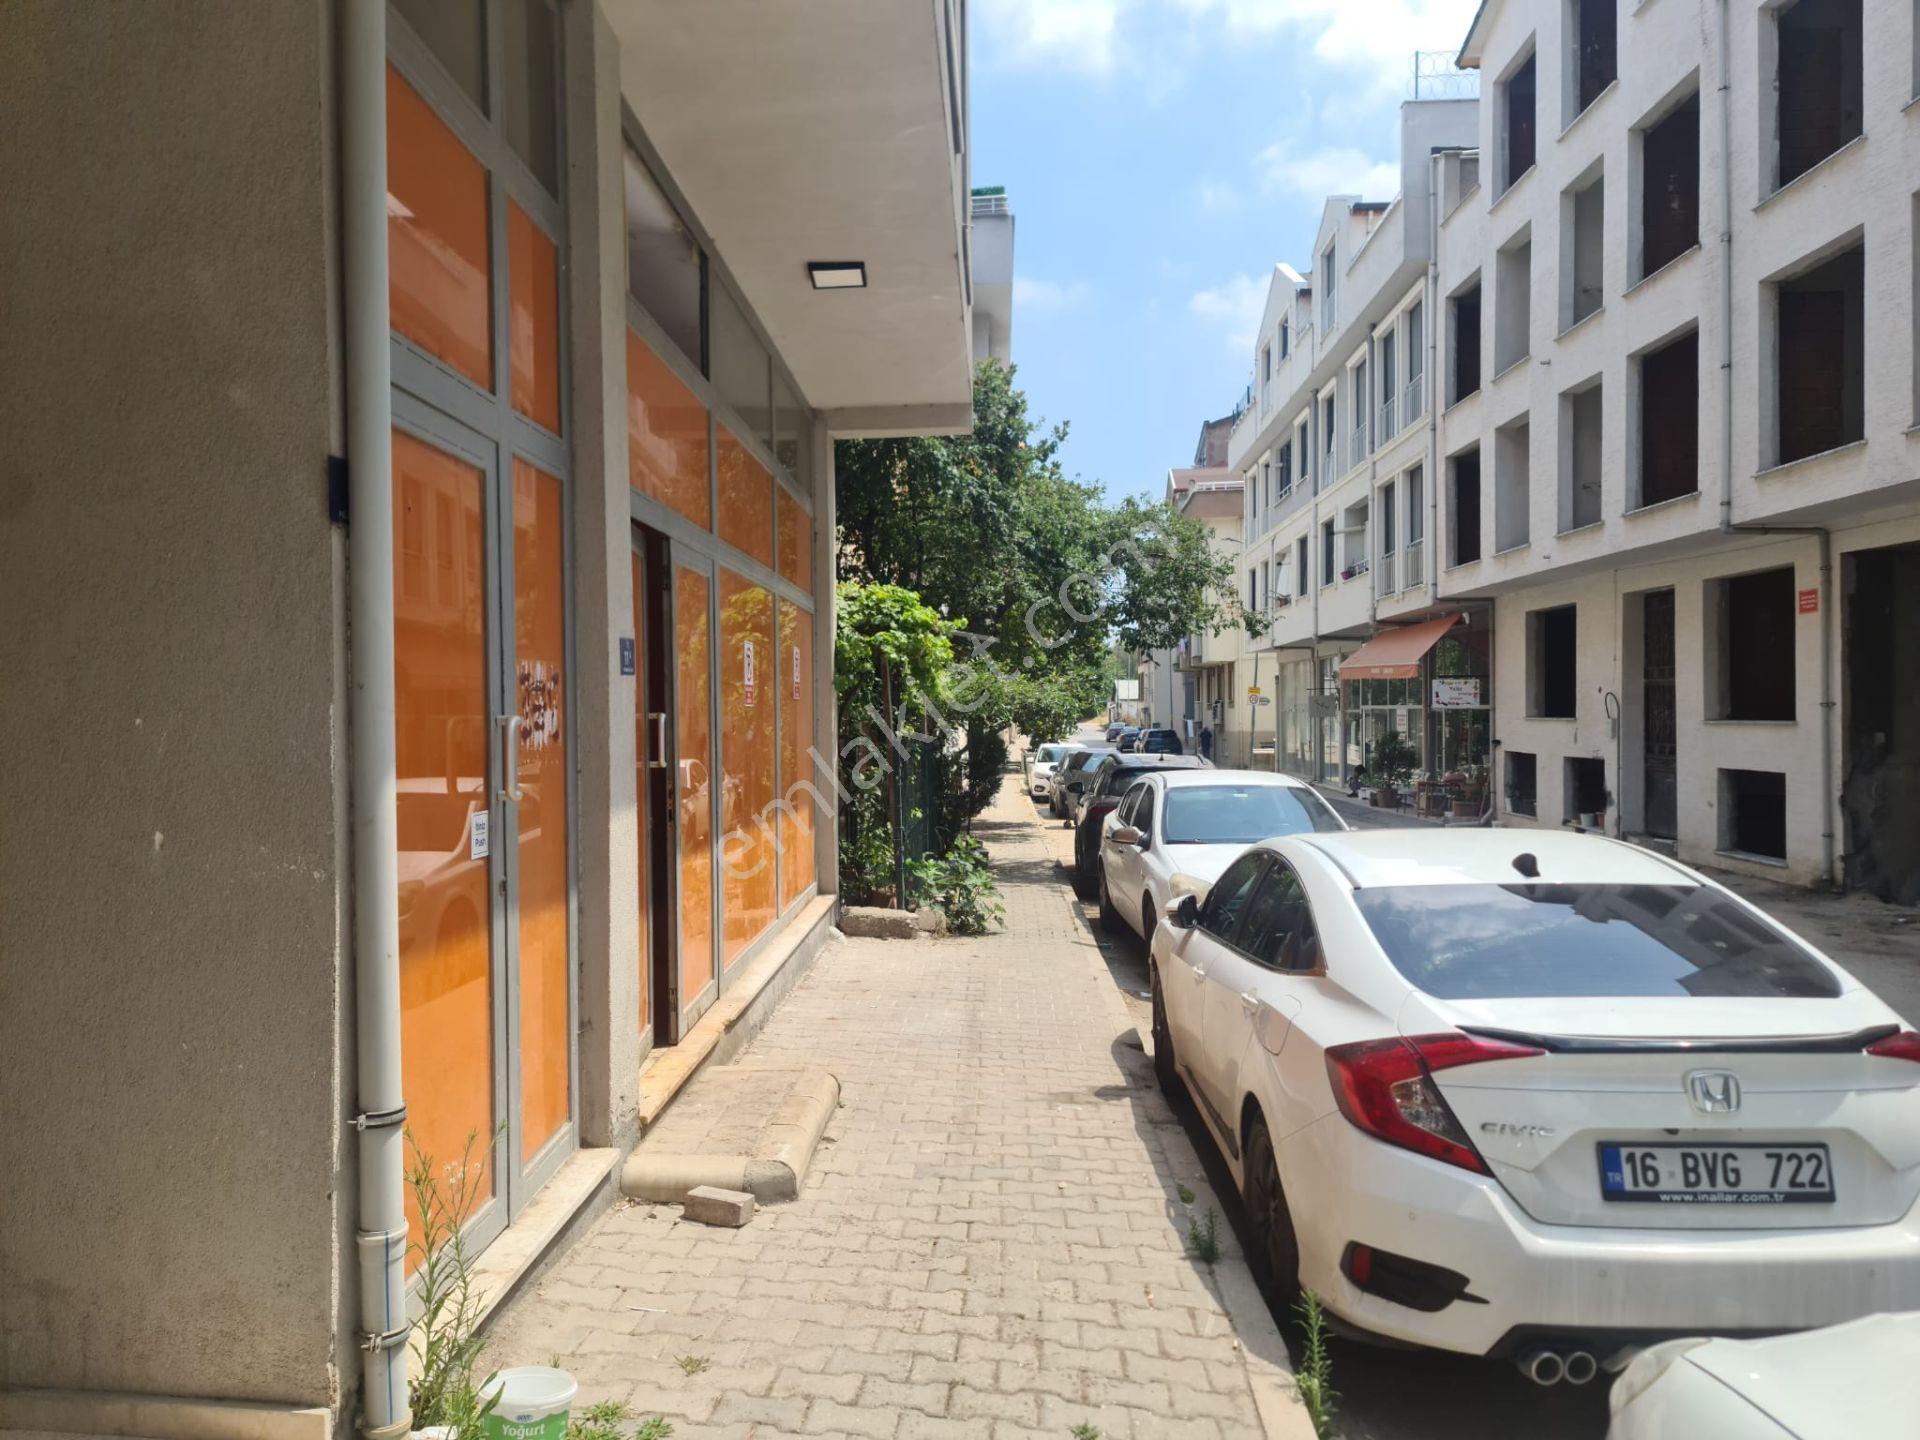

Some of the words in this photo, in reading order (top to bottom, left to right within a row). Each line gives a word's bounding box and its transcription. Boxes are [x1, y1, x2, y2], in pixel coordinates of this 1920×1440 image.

[1480, 1122, 1555, 1137] CIVIC
[1606, 1172, 1623, 1183] TR
[1625, 1152, 1660, 1188] 16
[1680, 1152, 1742, 1188] BVG
[1765, 1153, 1826, 1189] 722
[502, 1424, 545, 1439] Yoğurt
